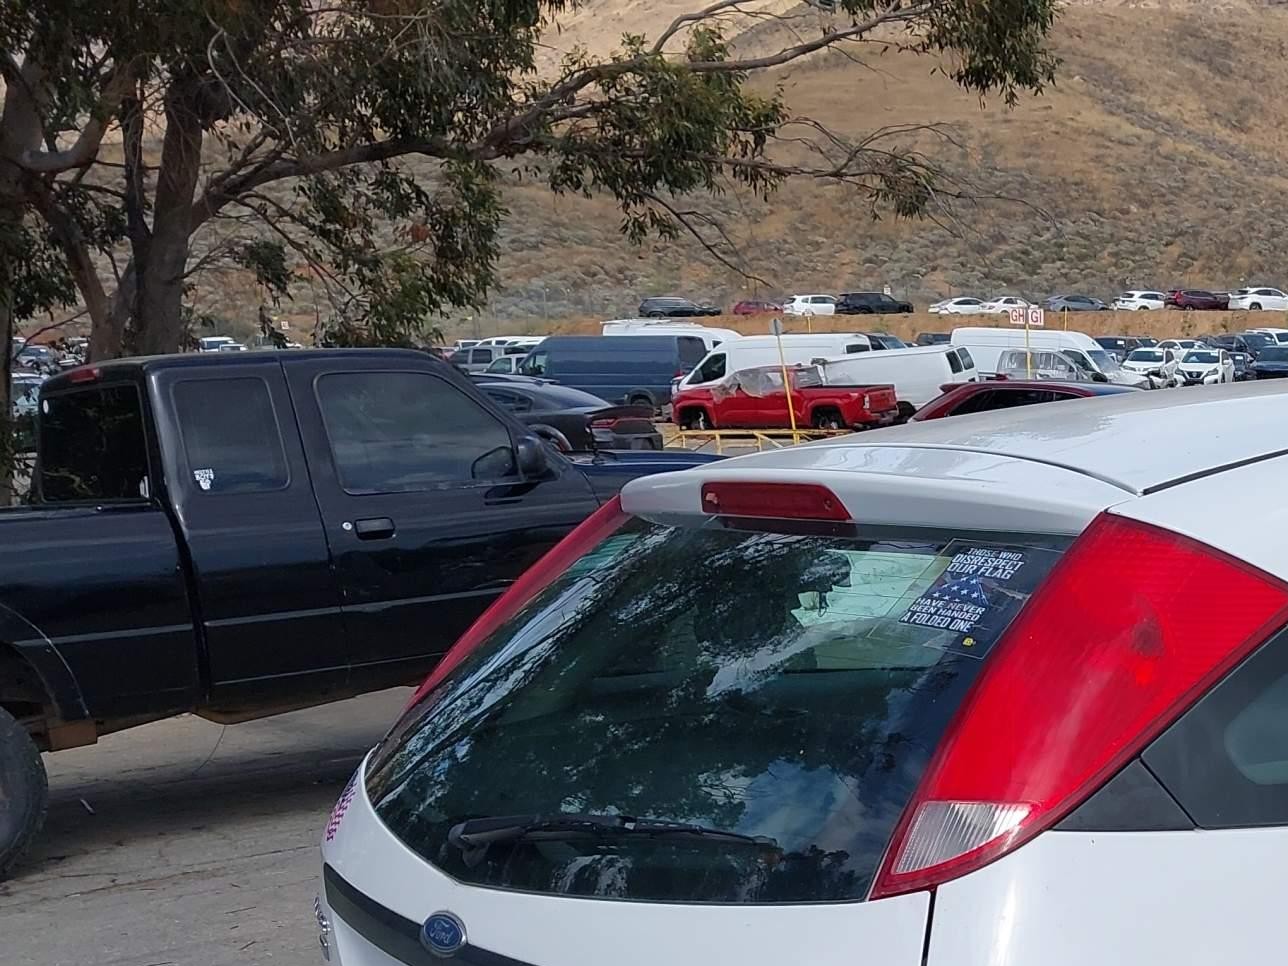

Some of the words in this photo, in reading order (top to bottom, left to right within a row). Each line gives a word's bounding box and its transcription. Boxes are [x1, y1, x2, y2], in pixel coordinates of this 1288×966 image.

[1011, 309, 1025, 323] GH
[952, 553, 1024, 571] DISRESPECT
[968, 548, 999, 557] THOSE
[999, 551, 1023, 560] WHO
[947, 562, 977, 574] OUR
[978, 566, 1014, 579] FLAG
[910, 604, 937, 614] BEEN
[937, 608, 980, 621] HANDED
[916, 597, 946, 608] HAVE
[947, 602, 986, 614] NEVER
[901, 611, 912, 622] A
[911, 612, 951, 628] FOLDED
[949, 619, 975, 632] ONE
